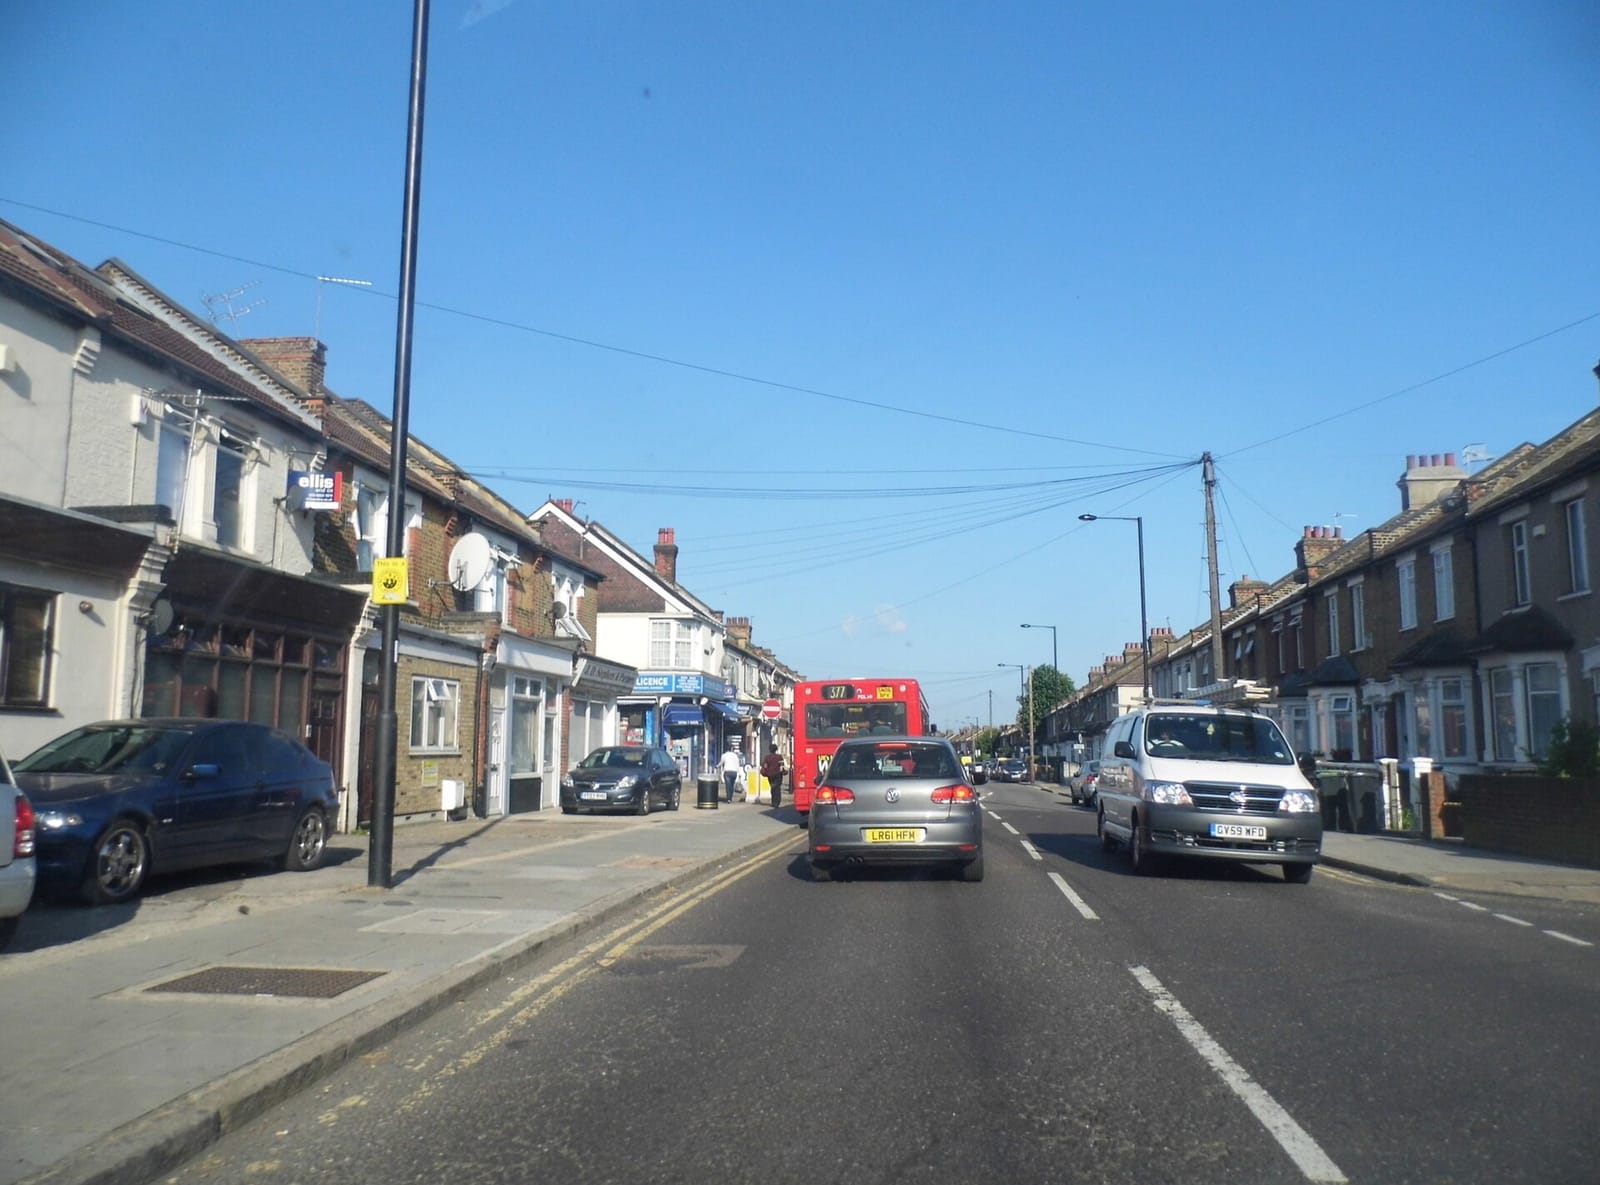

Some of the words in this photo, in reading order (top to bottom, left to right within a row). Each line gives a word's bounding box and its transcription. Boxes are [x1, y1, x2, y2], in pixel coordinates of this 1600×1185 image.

[298, 474, 334, 488] ellis
[636, 677, 669, 686] LICENCE
[829, 686, 846, 699] 377
[871, 830, 894, 841] LR61
[1216, 825, 1243, 835] GV59
